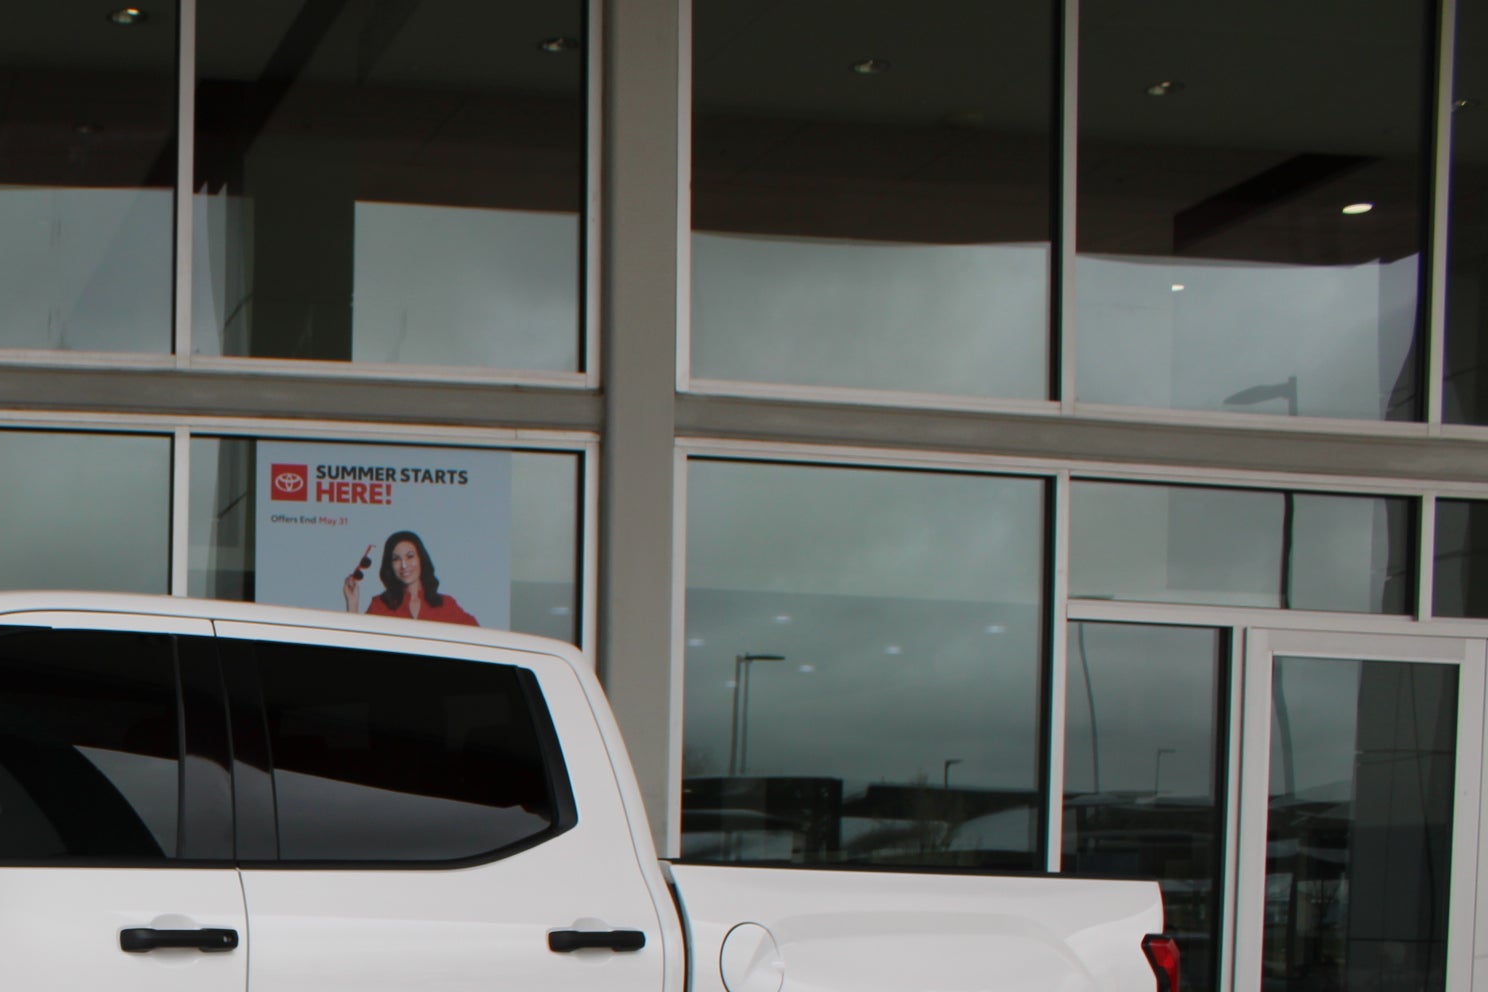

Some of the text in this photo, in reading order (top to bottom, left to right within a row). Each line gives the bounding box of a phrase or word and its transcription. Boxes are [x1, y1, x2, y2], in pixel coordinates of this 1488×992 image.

[316, 464, 468, 484] SUMMER STARTS
[316, 482, 392, 505] HERE!
[271, 514, 348, 526] Offers End May 31
